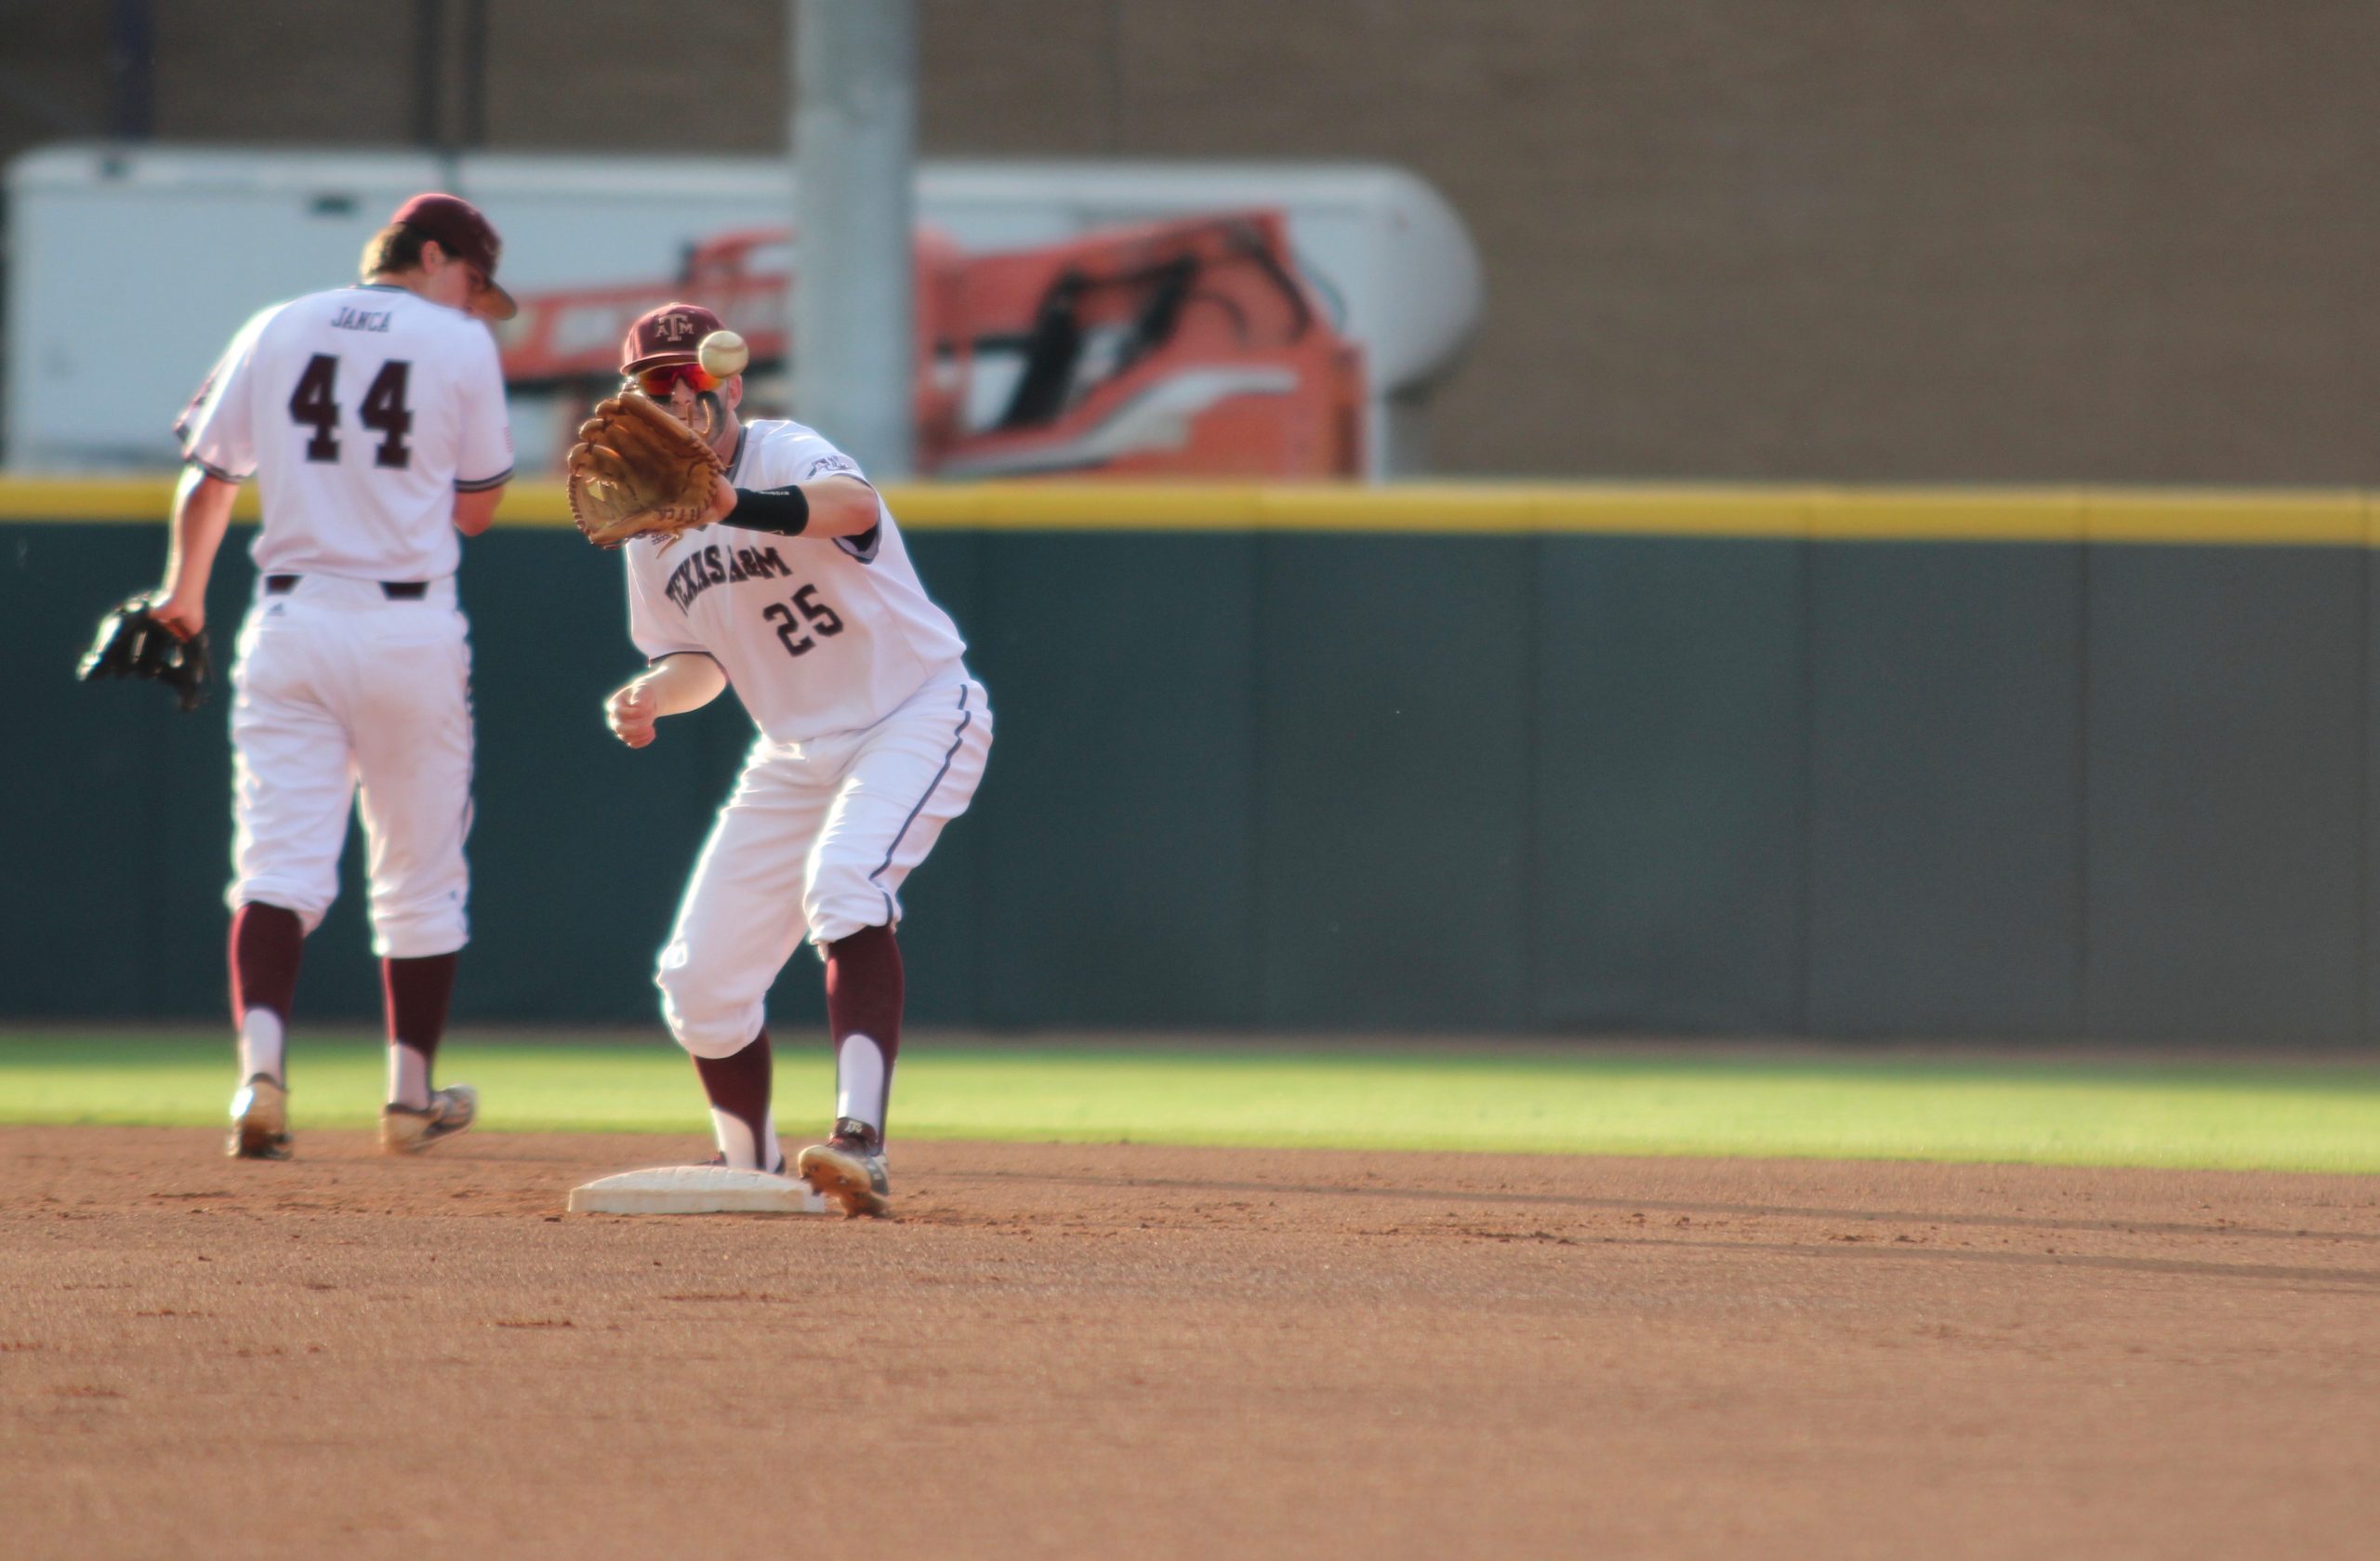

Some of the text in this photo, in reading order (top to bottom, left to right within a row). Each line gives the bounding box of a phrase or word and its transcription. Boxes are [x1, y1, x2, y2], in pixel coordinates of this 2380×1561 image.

[289, 352, 414, 470] 44
[665, 545, 793, 617] TEXAS A&M
[762, 584, 844, 657] 25
